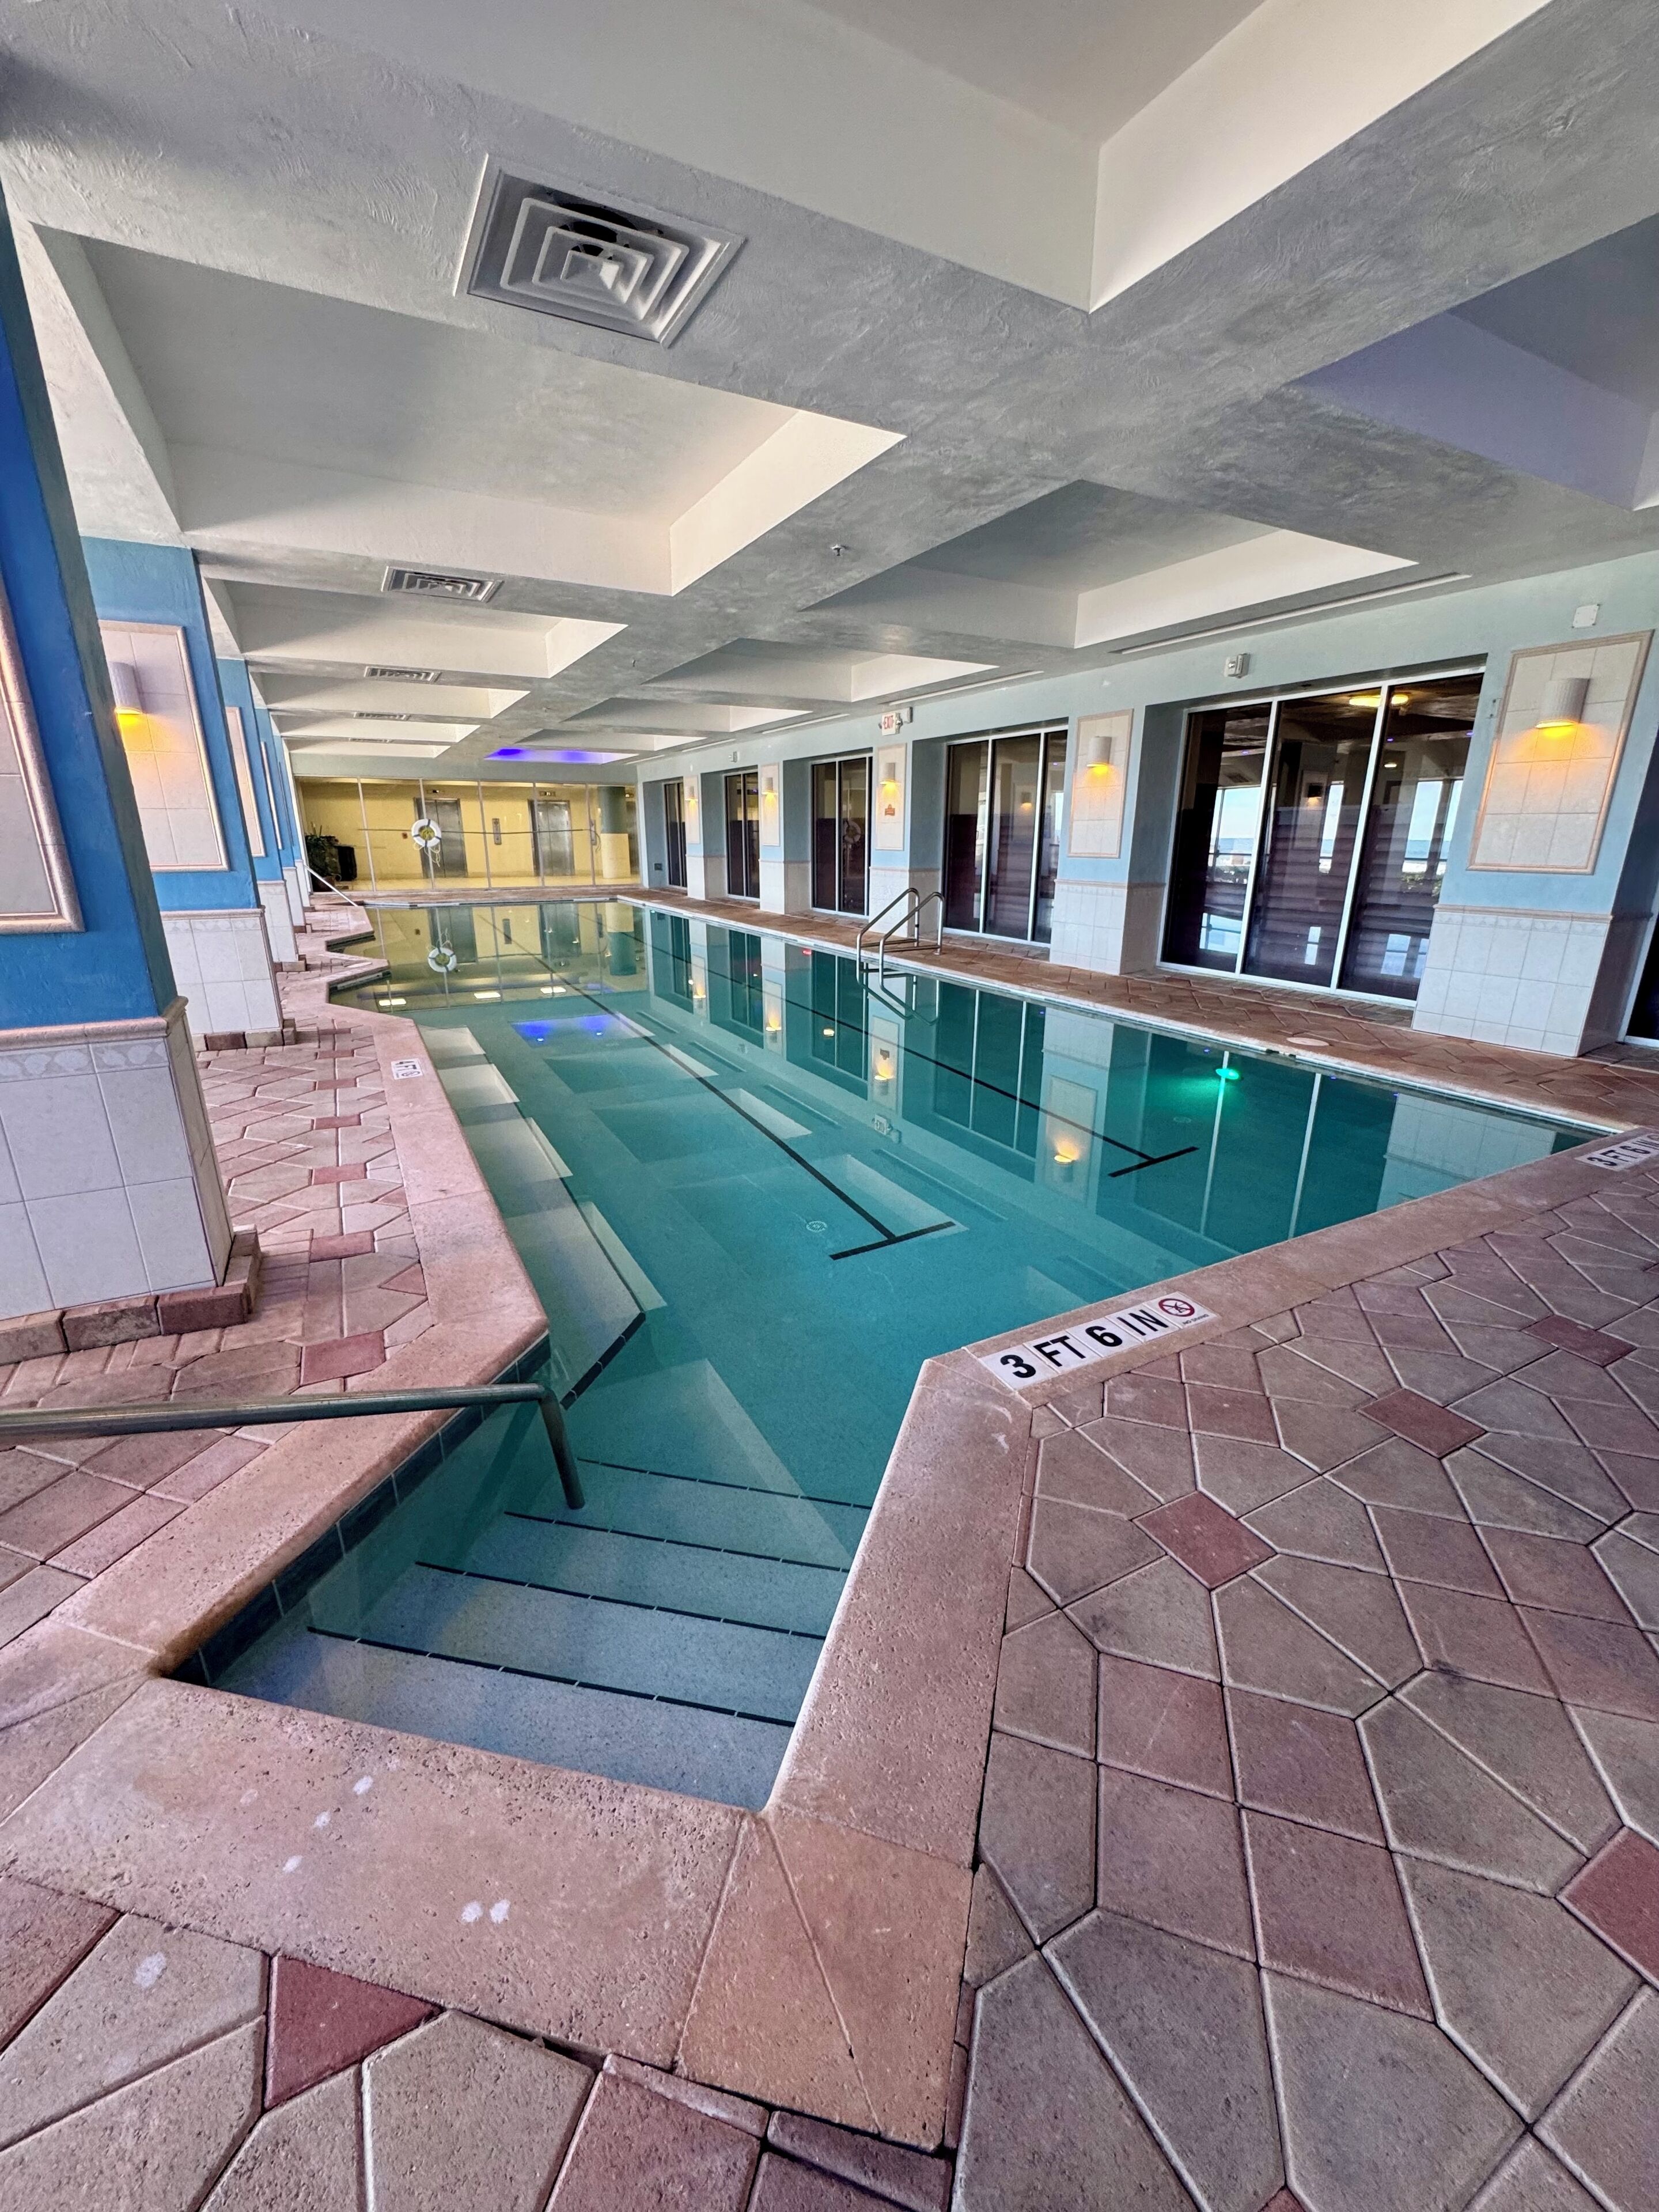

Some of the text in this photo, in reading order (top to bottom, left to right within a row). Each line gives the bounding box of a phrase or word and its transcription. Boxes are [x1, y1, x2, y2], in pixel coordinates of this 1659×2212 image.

[884, 715, 894, 730] EXIT
[1619, 1145, 1652, 1154] 6
[1600, 1149, 1639, 1162] FT
[1586, 1157, 1618, 1166] 3
[1191, 1313, 1209, 1322] DIVING
[1001, 1309, 1169, 1378] 3 FT 6 IN
